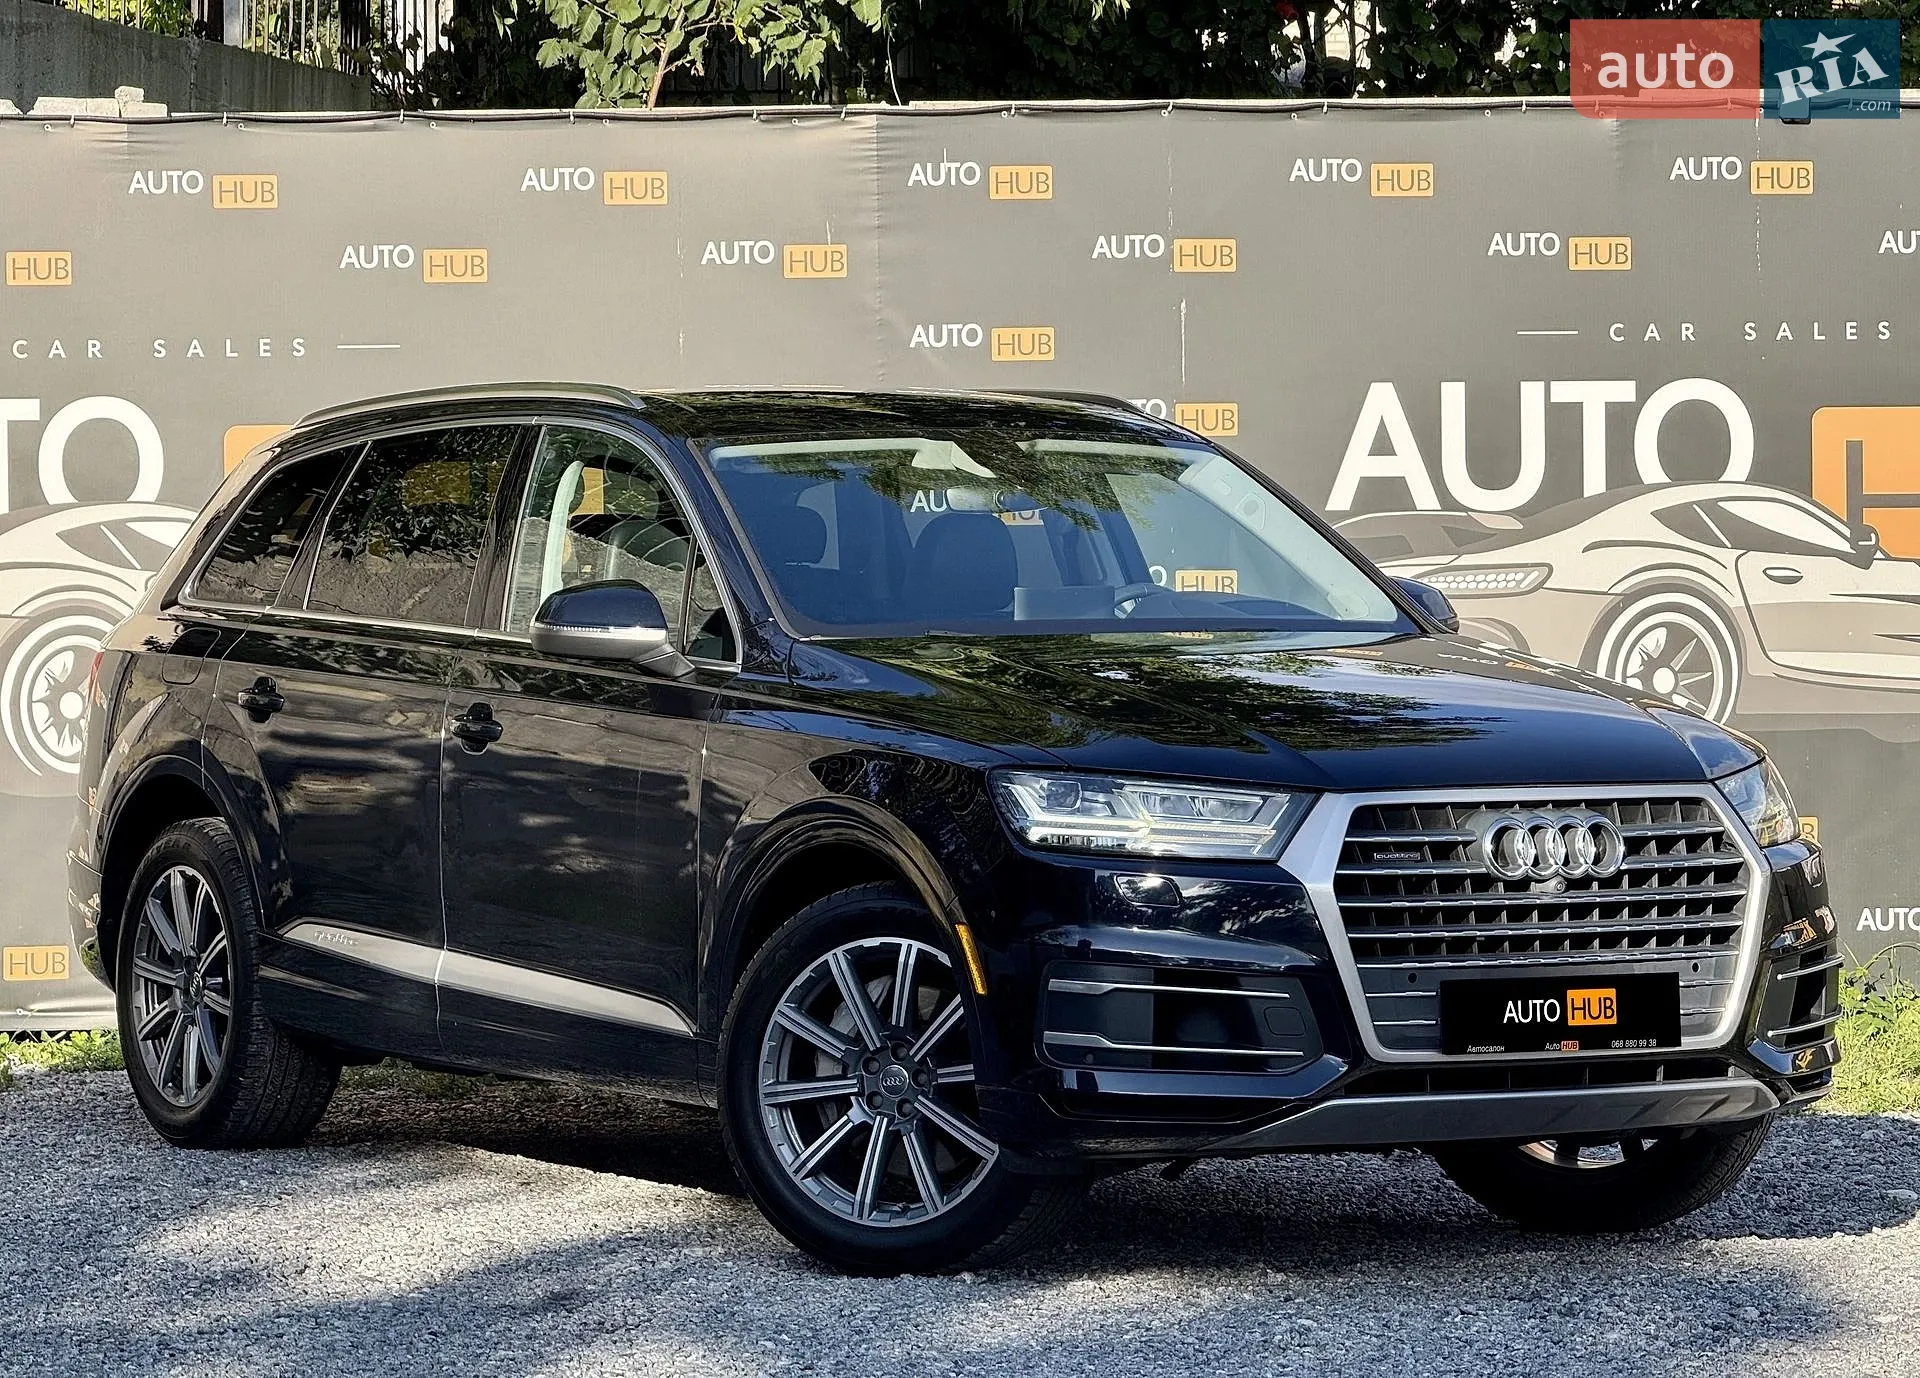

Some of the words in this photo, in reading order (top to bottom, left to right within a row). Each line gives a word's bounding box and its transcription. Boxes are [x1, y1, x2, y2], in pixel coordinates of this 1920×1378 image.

[129, 170, 203, 195] AUTO
[219, 181, 275, 203] HUB
[521, 167, 595, 191] AUTO
[610, 178, 664, 200] HUB
[908, 162, 981, 186] AUTO
[996, 172, 1049, 194] HUB
[1290, 158, 1363, 182] AUTO
[1377, 170, 1431, 192] HUB
[1670, 157, 1743, 181] AUTO
[1757, 167, 1811, 190] HUB
[340, 244, 414, 269] AUTO
[430, 255, 485, 277] HUB
[701, 241, 775, 265] AUTO
[790, 251, 844, 273] HUB
[1092, 234, 1165, 258] AUTO
[1180, 245, 1233, 267] HUB
[1488, 232, 1561, 256] AUTO
[1575, 243, 1629, 266] HUB
[13, 257, 69, 281] HUB
[910, 324, 983, 347] AUTO
[998, 334, 1052, 356] HUB
[1609, 322, 1696, 342] CAR
[1744, 321, 1891, 341] SALES
[12, 340, 103, 359] CAR
[153, 338, 305, 358] SALES
[1181, 408, 1235, 431] HUB
[1325, 377, 1755, 512] AUTO
[9, 951, 67, 976] HUB
[1503, 999, 1561, 1024] AUTO
[1571, 997, 1615, 1021] HUB
[1466, 1044, 1505, 1053] Автосалон
[1562, 1041, 1578, 1050] HUB
[1639, 1039, 1647, 1047] 99
[1648, 1038, 1656, 1047] 38
